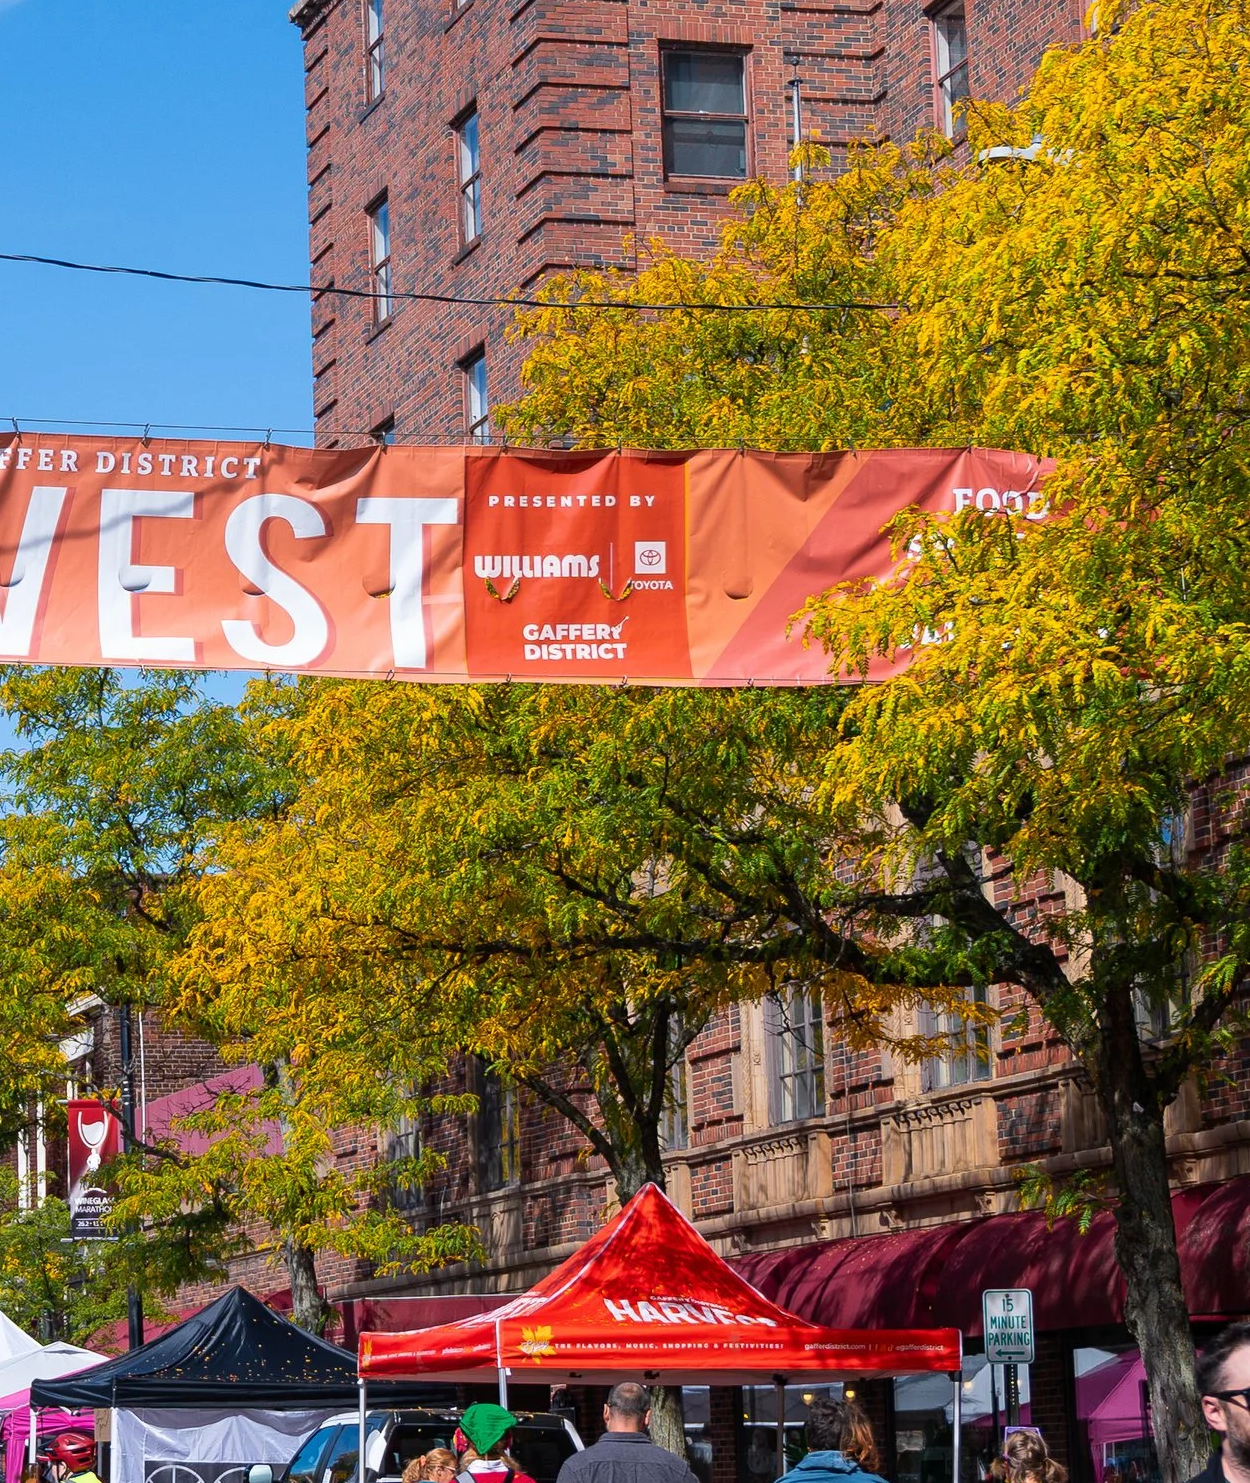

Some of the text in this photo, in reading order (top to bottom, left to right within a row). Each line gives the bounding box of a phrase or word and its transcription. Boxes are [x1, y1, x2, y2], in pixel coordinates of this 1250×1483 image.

[95, 451, 261, 479] DISTRICT
[488, 494, 656, 508] PRESENTED BY
[474, 554, 600, 579] WILLIAMS
[628, 580, 673, 591] TOYOTA
[522, 622, 622, 642] GAFFER
[524, 643, 628, 661] DISTRICT
[75, 1197, 115, 1205] WINEGLA
[1002, 1298, 1014, 1312] 15
[990, 1315, 1027, 1329] MINUTE
[988, 1332, 1031, 1346] PARKING
[804, 1343, 866, 1351] gafferdistrict.com
